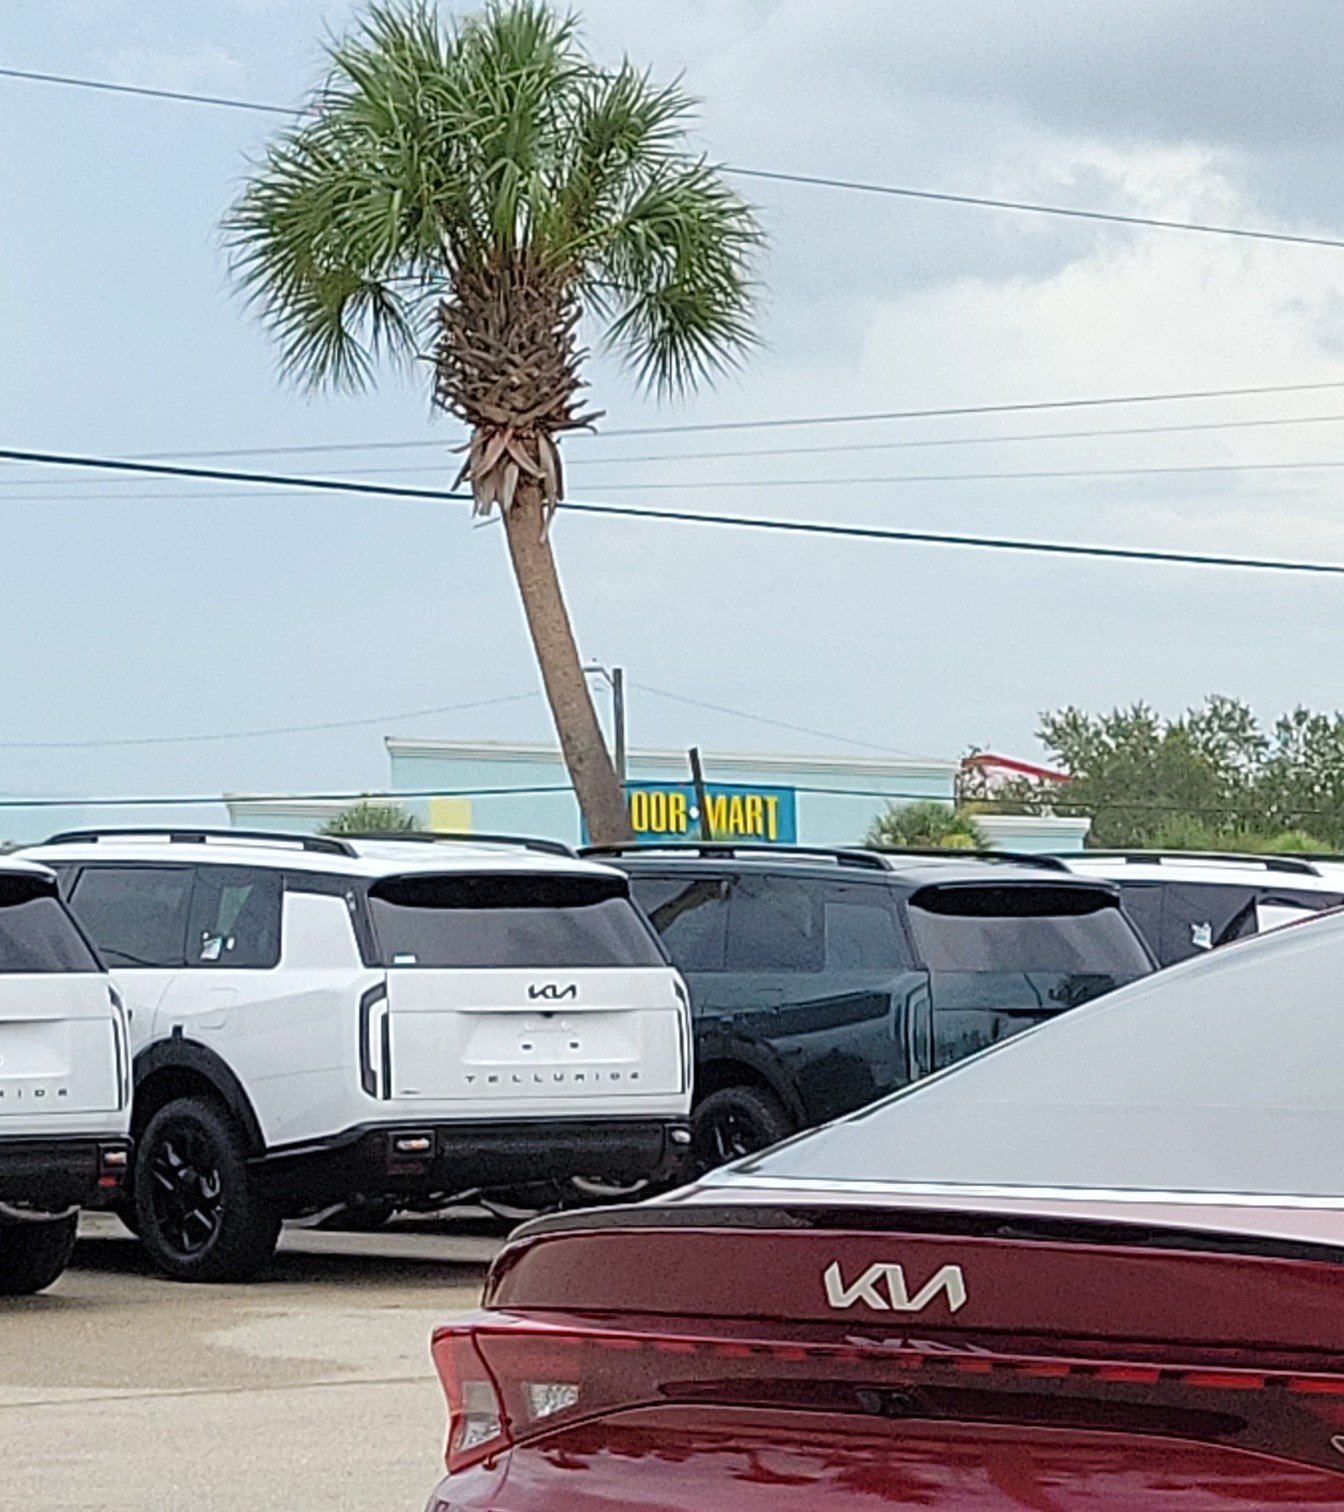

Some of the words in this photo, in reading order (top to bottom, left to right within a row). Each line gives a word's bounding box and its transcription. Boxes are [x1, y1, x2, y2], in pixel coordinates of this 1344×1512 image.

[630, 790, 688, 834] OOR
[702, 793, 779, 841] MART
[824, 1259, 968, 1313] KIA
